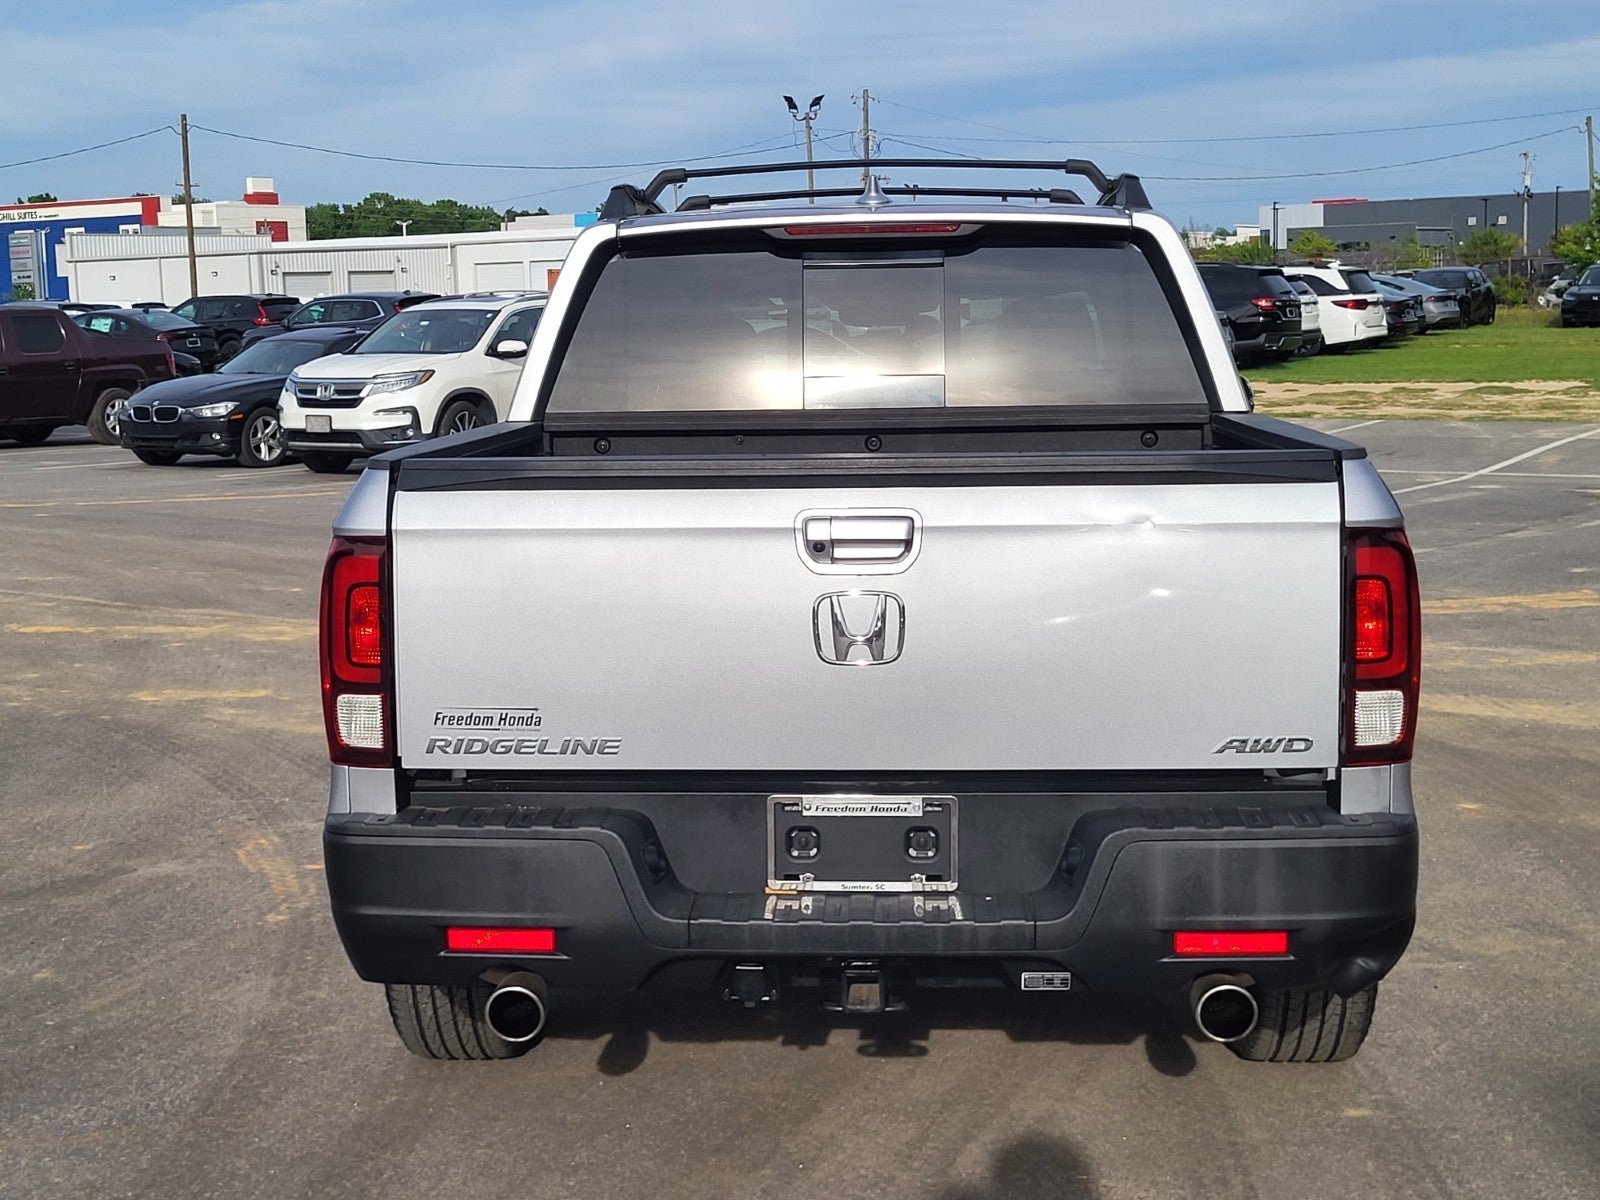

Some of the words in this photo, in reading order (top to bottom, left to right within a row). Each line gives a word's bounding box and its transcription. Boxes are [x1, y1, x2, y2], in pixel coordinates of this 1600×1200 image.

[17, 211, 38, 220] SUITES
[433, 711, 494, 726] Freedom
[498, 712, 542, 727] Honda
[425, 737, 623, 755] RIDGELINE
[1212, 737, 1314, 754] AWD
[870, 805, 908, 813] Honda
